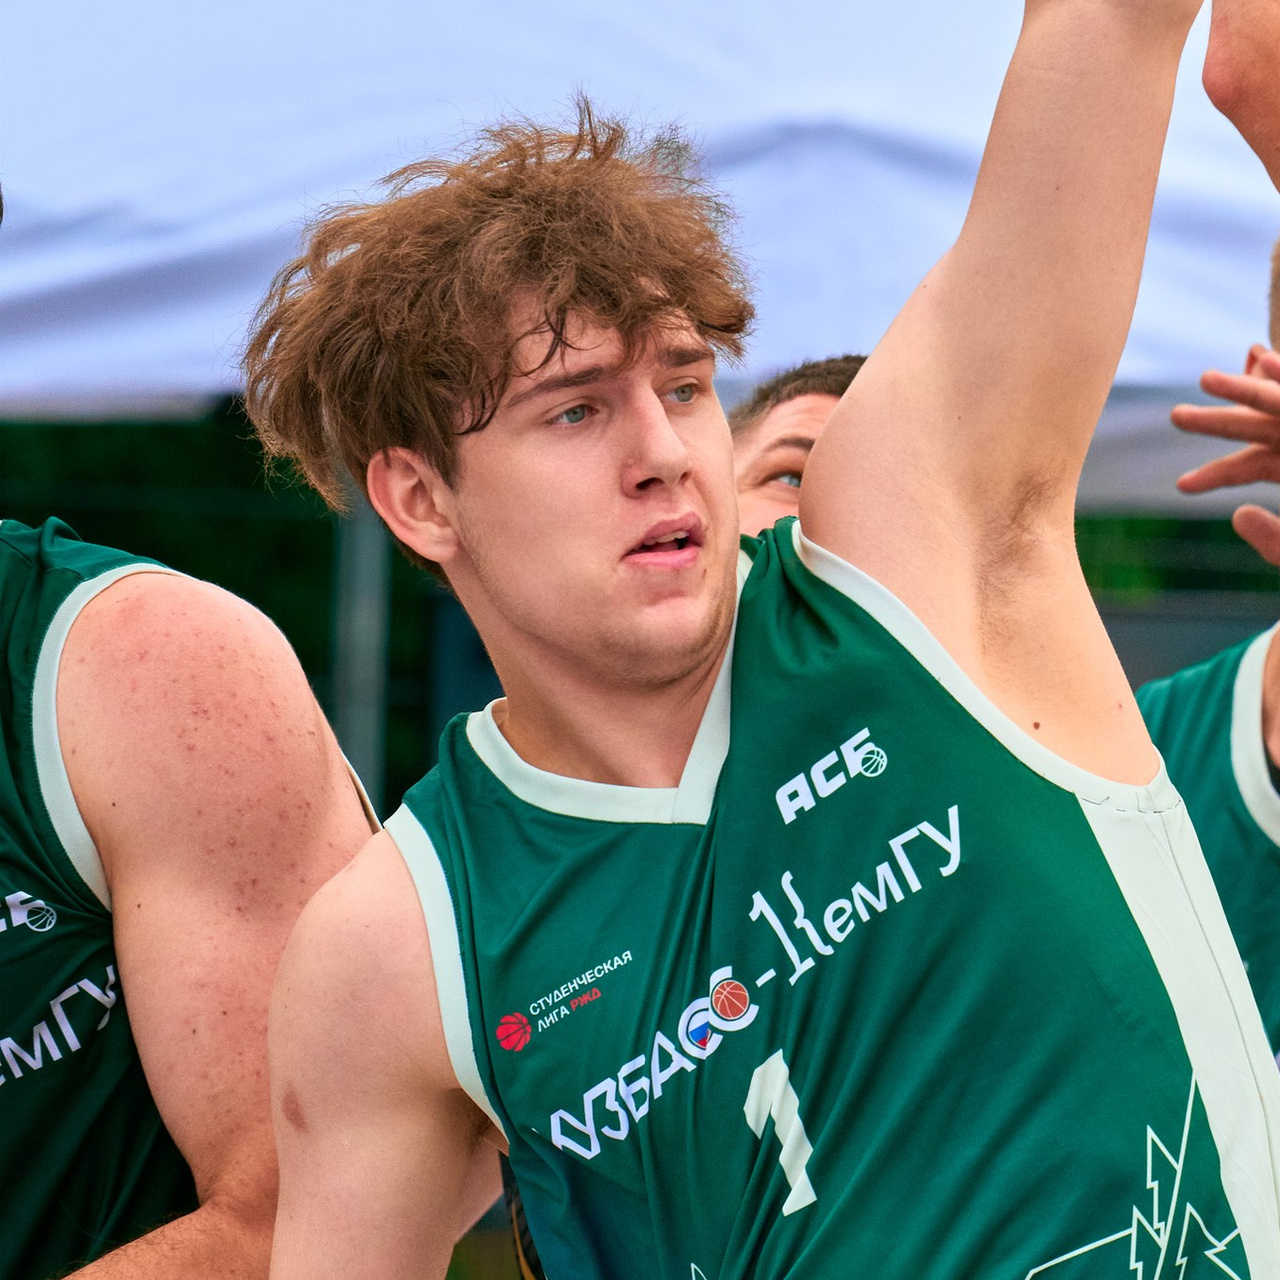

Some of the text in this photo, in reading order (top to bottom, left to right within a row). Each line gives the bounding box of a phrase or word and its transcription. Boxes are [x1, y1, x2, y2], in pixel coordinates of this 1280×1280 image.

[529, 950, 633, 1016] СТУДЕНЧЕСКАЯ
[537, 987, 602, 1033] ЛИГА РЖД
[743, 1048, 818, 1217] 1
